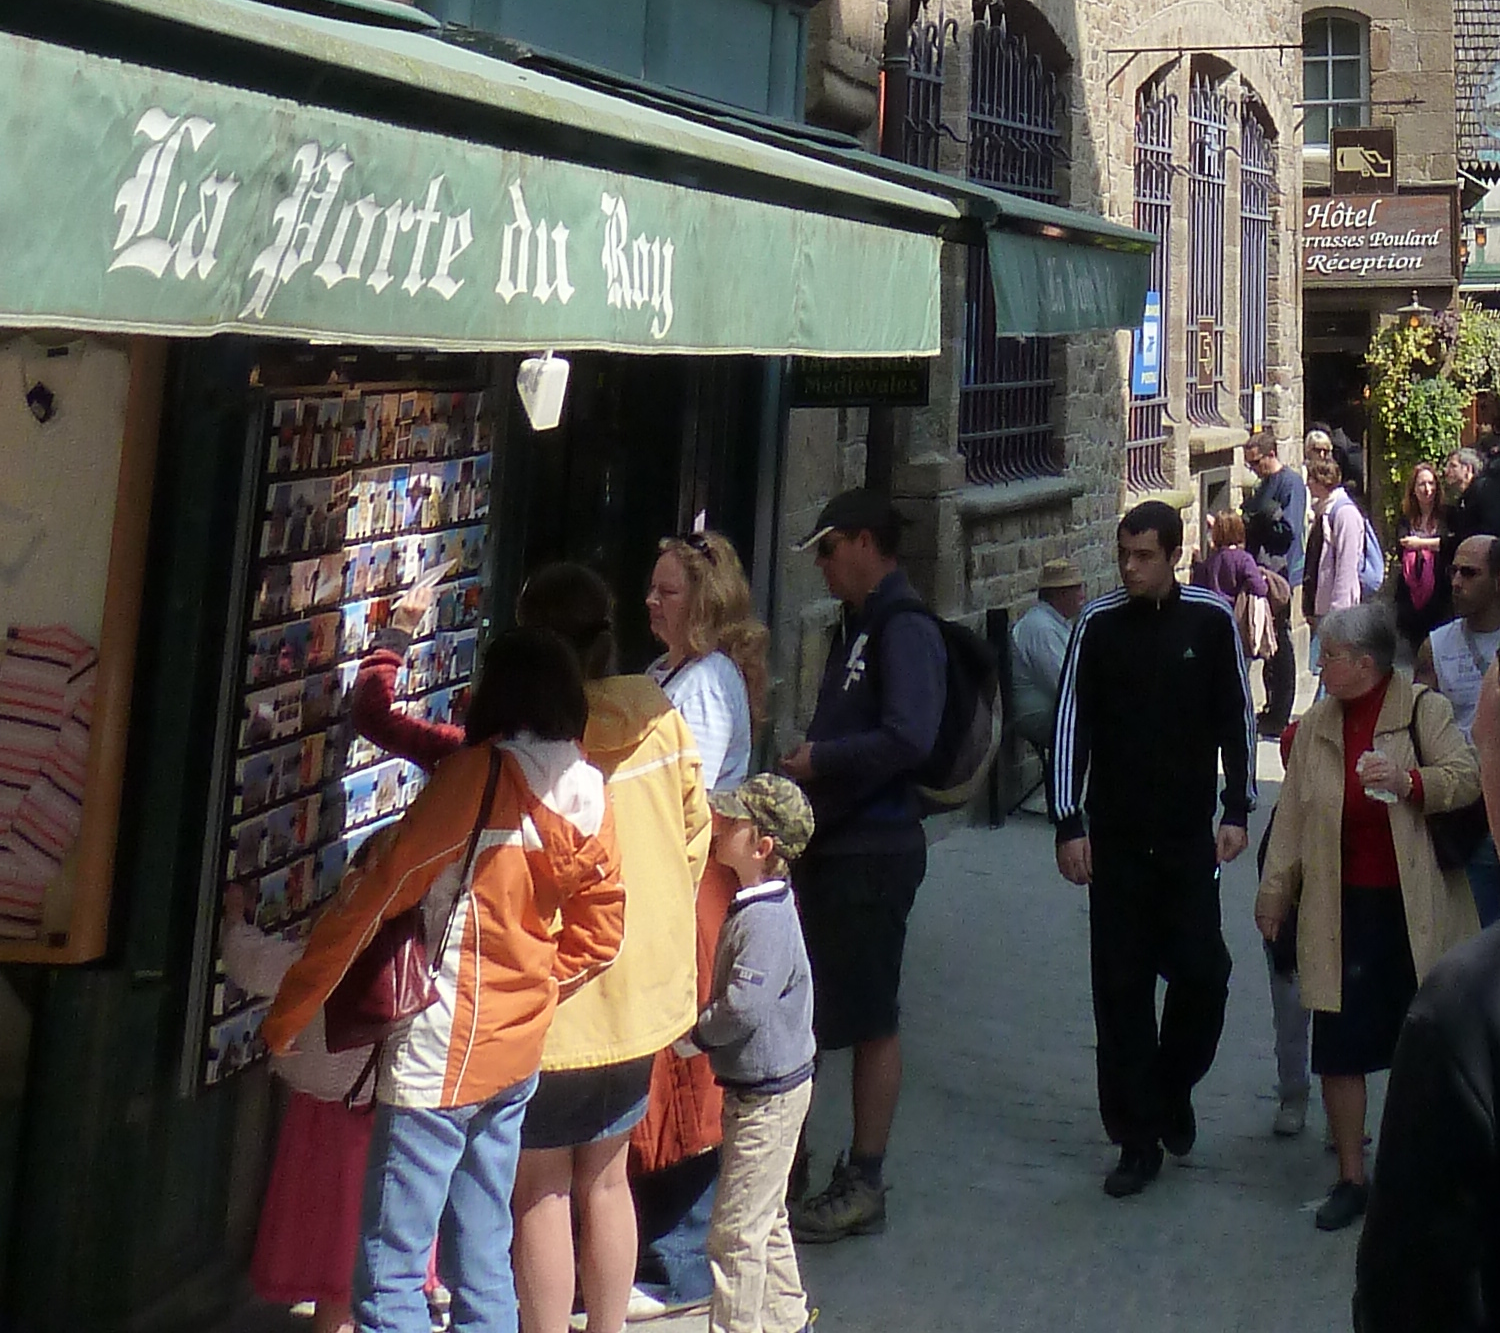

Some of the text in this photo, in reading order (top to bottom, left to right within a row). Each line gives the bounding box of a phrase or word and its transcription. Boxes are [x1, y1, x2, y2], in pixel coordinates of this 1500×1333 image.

[107, 107, 675, 340] La Porte du Roy
[1304, 198, 1383, 229] Hôtel
[1301, 228, 1444, 248] rrasses Poulard
[1305, 252, 1424, 277] Réception
